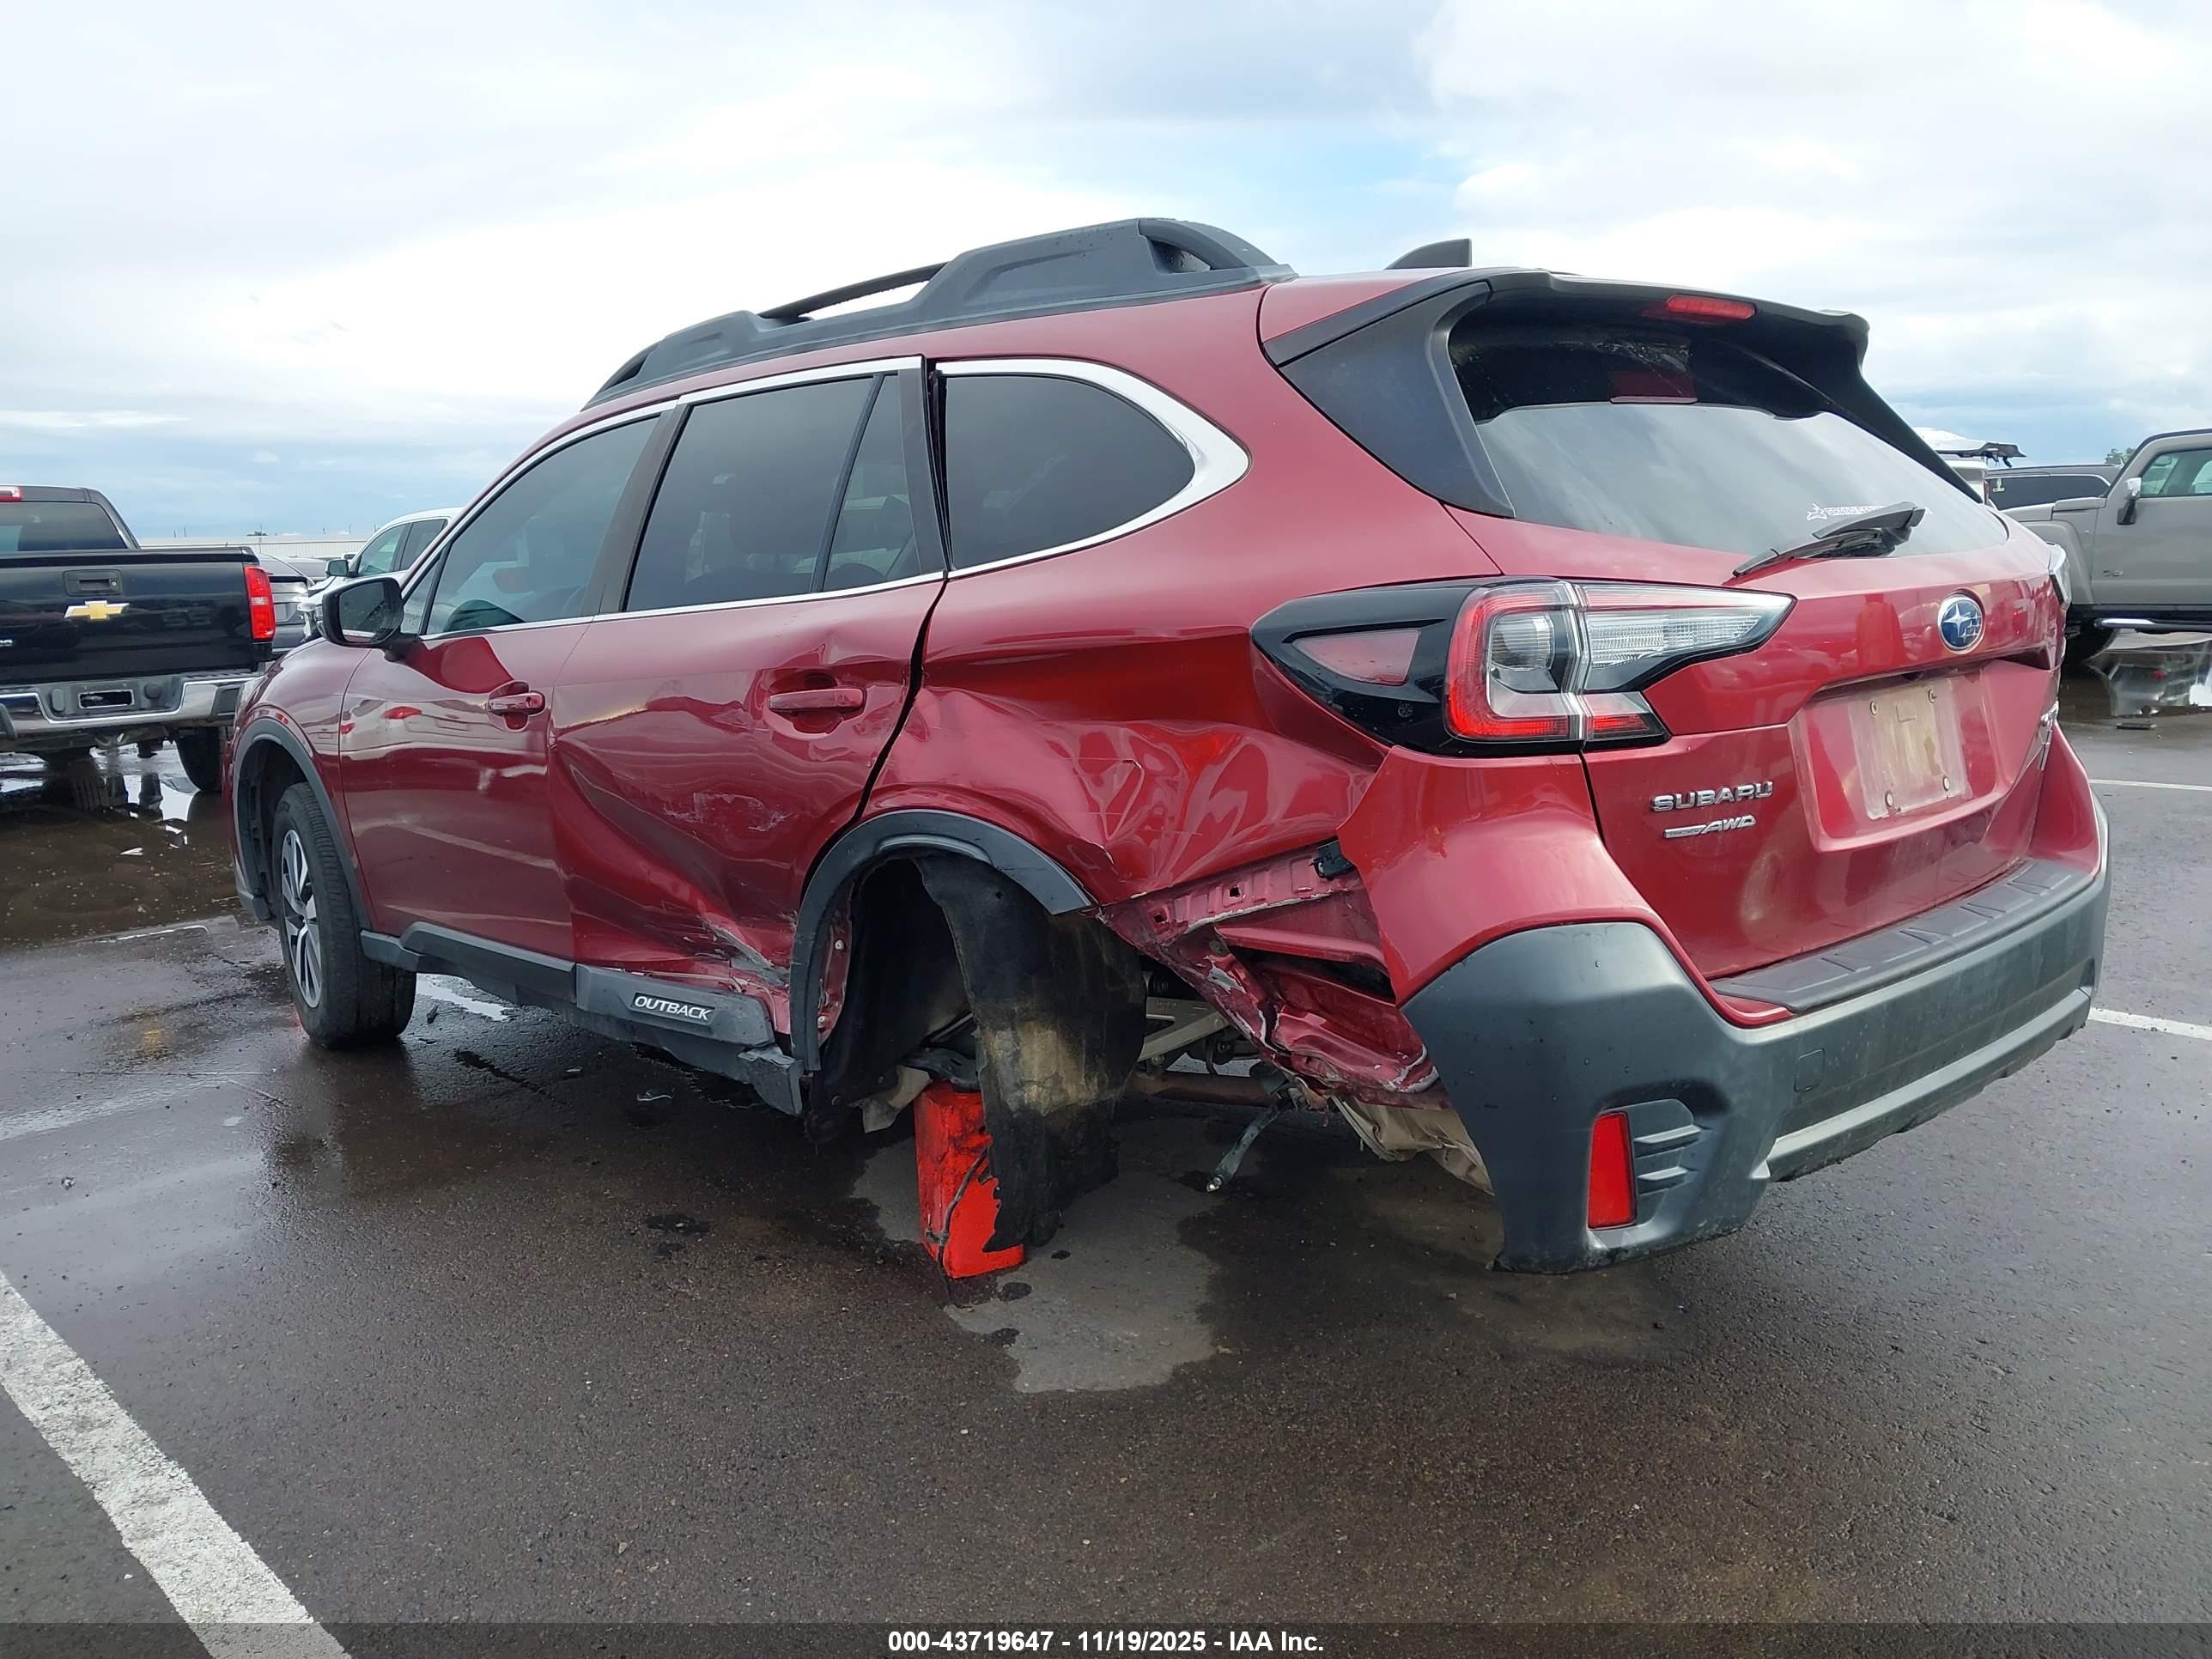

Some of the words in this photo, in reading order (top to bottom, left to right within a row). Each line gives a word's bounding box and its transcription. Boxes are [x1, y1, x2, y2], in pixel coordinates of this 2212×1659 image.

[1651, 781, 1773, 812] SUBARU
[1701, 814, 1756, 834] AWD
[635, 996, 712, 1020] OUTBACK
